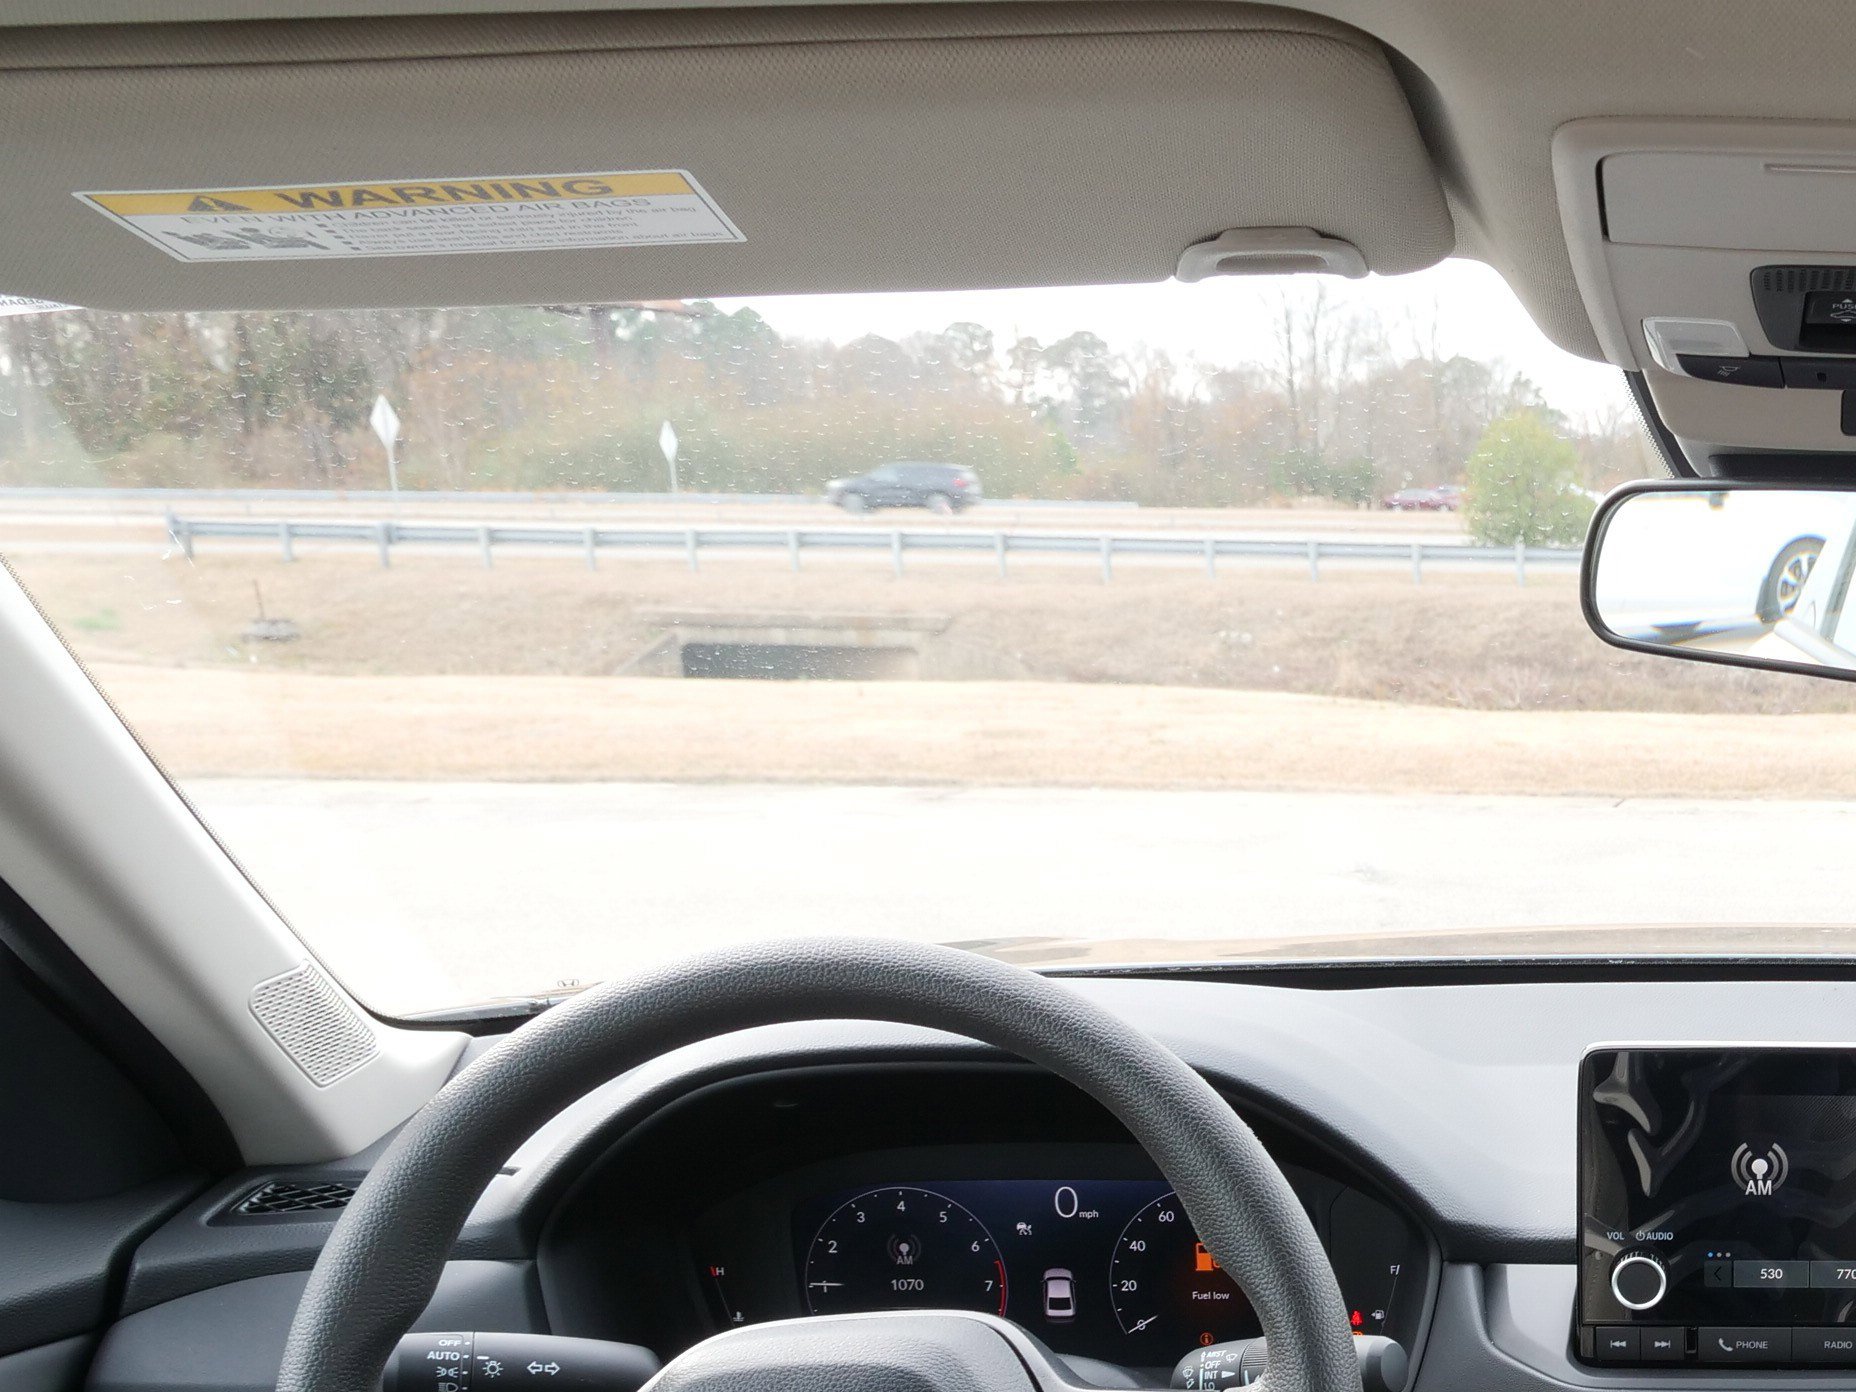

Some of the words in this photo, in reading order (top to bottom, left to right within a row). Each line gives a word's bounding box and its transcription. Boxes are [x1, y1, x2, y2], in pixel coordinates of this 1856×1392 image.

[273, 179, 613, 208] WARNING
[181, 215, 262, 224] EVEN
[268, 212, 346, 222] WITH
[354, 204, 509, 219] ADVANCED
[519, 203, 565, 212] AIR
[571, 198, 651, 209] BAGS
[1744, 1179, 1773, 1196] AM
[897, 1201, 906, 1212] 4
[1054, 1186, 1079, 1218] 0
[1079, 1210, 1099, 1221] mph
[857, 1211, 866, 1224] 3
[939, 1211, 948, 1223] 5
[1158, 1210, 1175, 1223] 60
[1606, 1231, 1625, 1241] VOL
[1646, 1231, 1674, 1241] AUDIO
[828, 1240, 838, 1254] 2
[971, 1240, 980, 1253] 6
[1129, 1240, 1147, 1253] 40
[895, 1256, 914, 1266] AM
[716, 1267, 724, 1276] H
[1760, 1268, 1783, 1280] 530
[891, 1279, 925, 1292] 1070
[984, 1280, 994, 1292] 7
[1121, 1280, 1137, 1292] 20
[1191, 1291, 1211, 1301] Fuel
[1213, 1291, 1230, 1300] low
[438, 1339, 461, 1347] OFF
[1736, 1340, 1769, 1349] PHONE
[1824, 1340, 1853, 1349] RADIO
[427, 1351, 460, 1361] AUTO
[1206, 1350, 1228, 1358] MIST
[1204, 1360, 1221, 1370] OFF
[1204, 1371, 1218, 1380] INT
[1204, 1382, 1215, 1390] LO
